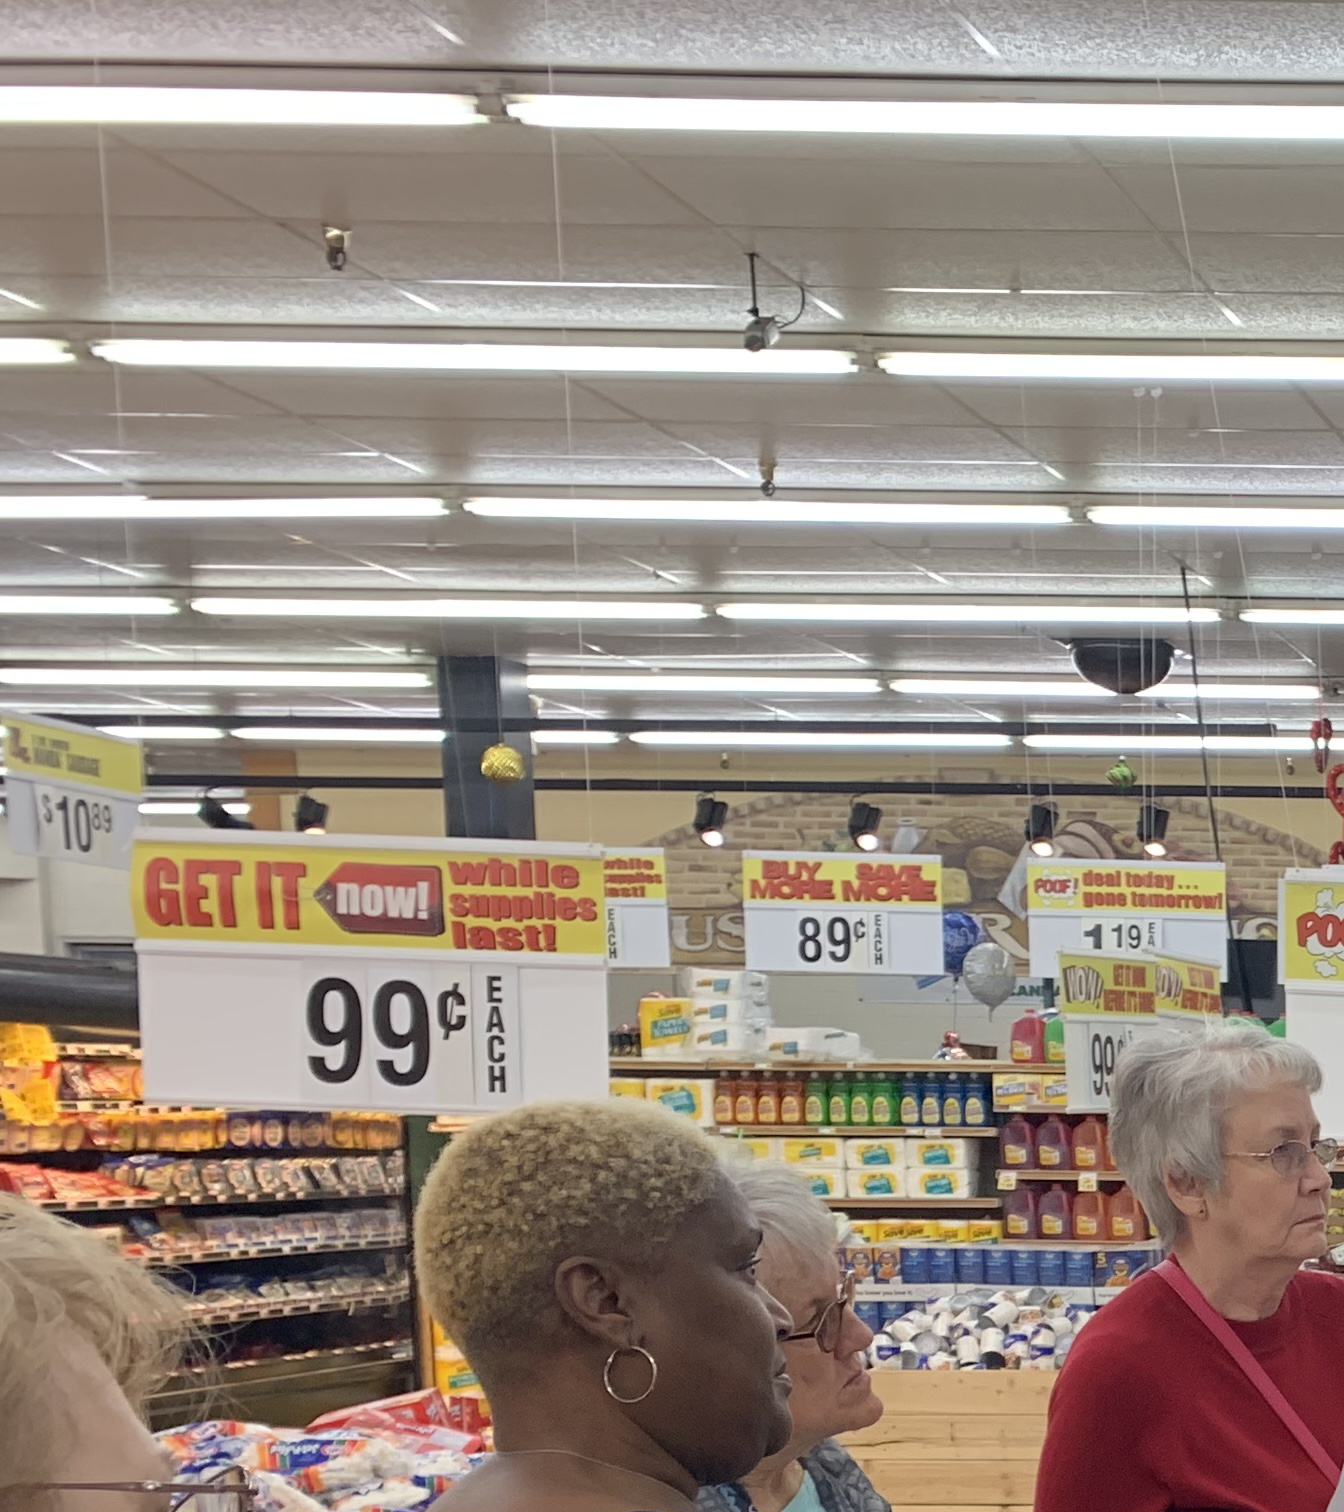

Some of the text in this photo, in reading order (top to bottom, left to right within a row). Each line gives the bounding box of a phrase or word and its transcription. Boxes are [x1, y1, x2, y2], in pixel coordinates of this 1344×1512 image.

[448, 858, 580, 890] while
[761, 859, 923, 883] BUY SAVE
[1033, 876, 1079, 896] POOF!
[1082, 869, 1122, 888] deal
[144, 856, 307, 931] GET IT
[335, 880, 430, 921] now!
[749, 878, 938, 903] MORE MORE
[1082, 890, 1224, 911] gone tomorrow!
[449, 891, 598, 923] supplies
[451, 921, 558, 953] last!
[607, 907, 618, 959] EACH
[798, 916, 867, 964] 89¢
[873, 913, 884, 966] EACH
[1147, 921, 1157, 948] EA
[1063, 964, 1104, 1009] WOW!
[306, 976, 467, 1088] 99¢
[486, 975, 507, 1094] EACH
